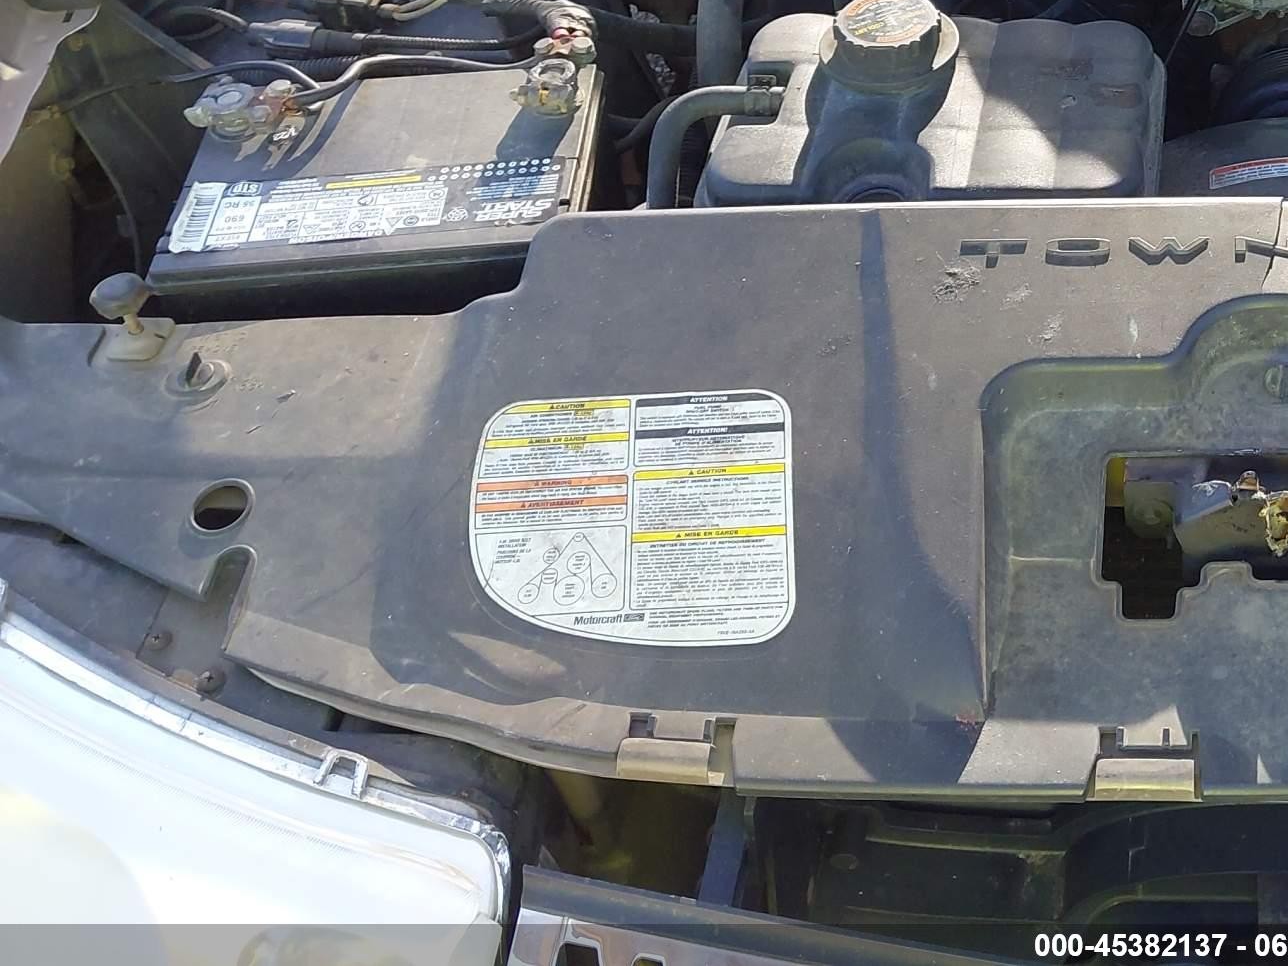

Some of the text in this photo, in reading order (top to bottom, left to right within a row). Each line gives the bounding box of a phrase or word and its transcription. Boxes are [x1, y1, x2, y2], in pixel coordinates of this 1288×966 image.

[473, 209, 542, 222] SUPER
[690, 395, 728, 404] ATTENTION
[687, 427, 728, 435] ATTENTION!
[528, 499, 584, 508] AVERTISSEMENT
[573, 614, 623, 626] Motorcraft
